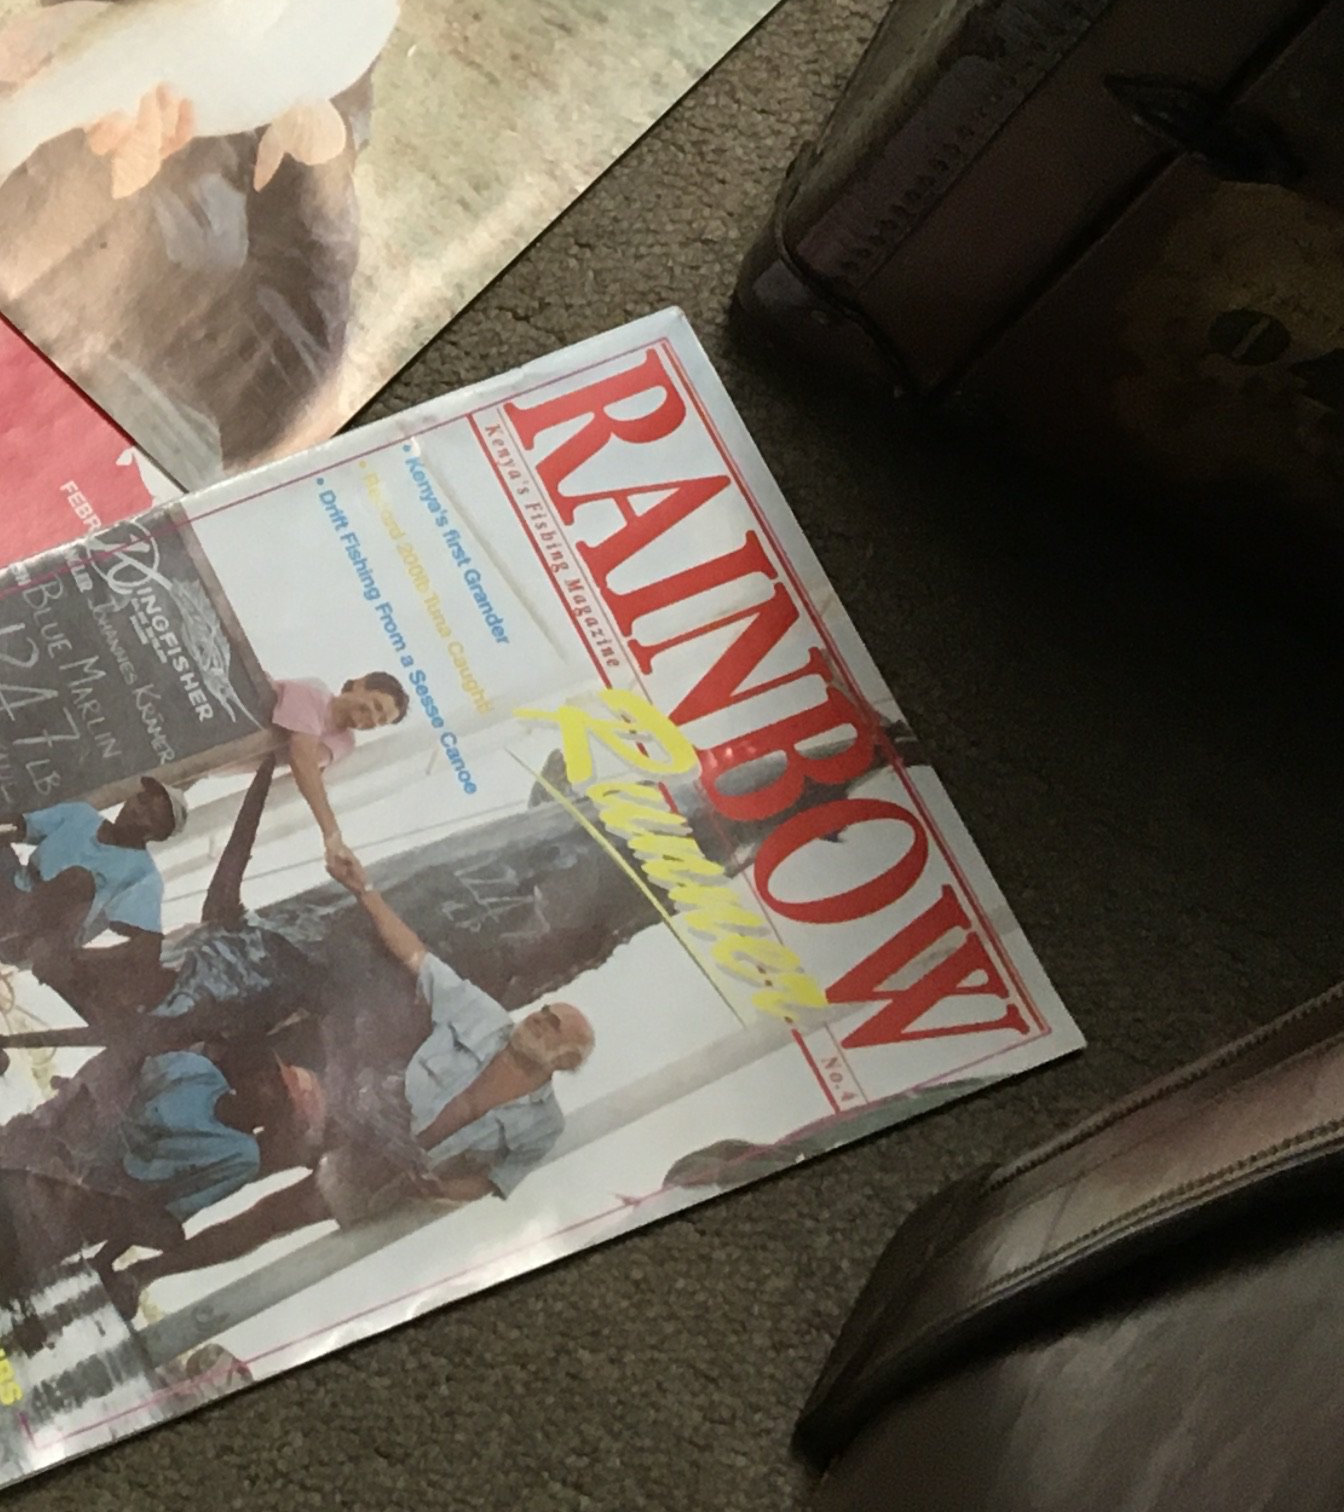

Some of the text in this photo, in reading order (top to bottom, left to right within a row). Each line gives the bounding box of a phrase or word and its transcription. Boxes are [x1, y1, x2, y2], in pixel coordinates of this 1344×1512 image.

[365, 471, 406, 540] Reord
[404, 457, 510, 645] Kenya's first Grander
[484, 422, 620, 668] Kenya's Fishing Magazine
[318, 489, 477, 795] Drift Fishing From a Sesse Canoe
[504, 348, 1030, 1051] RAINBOW
